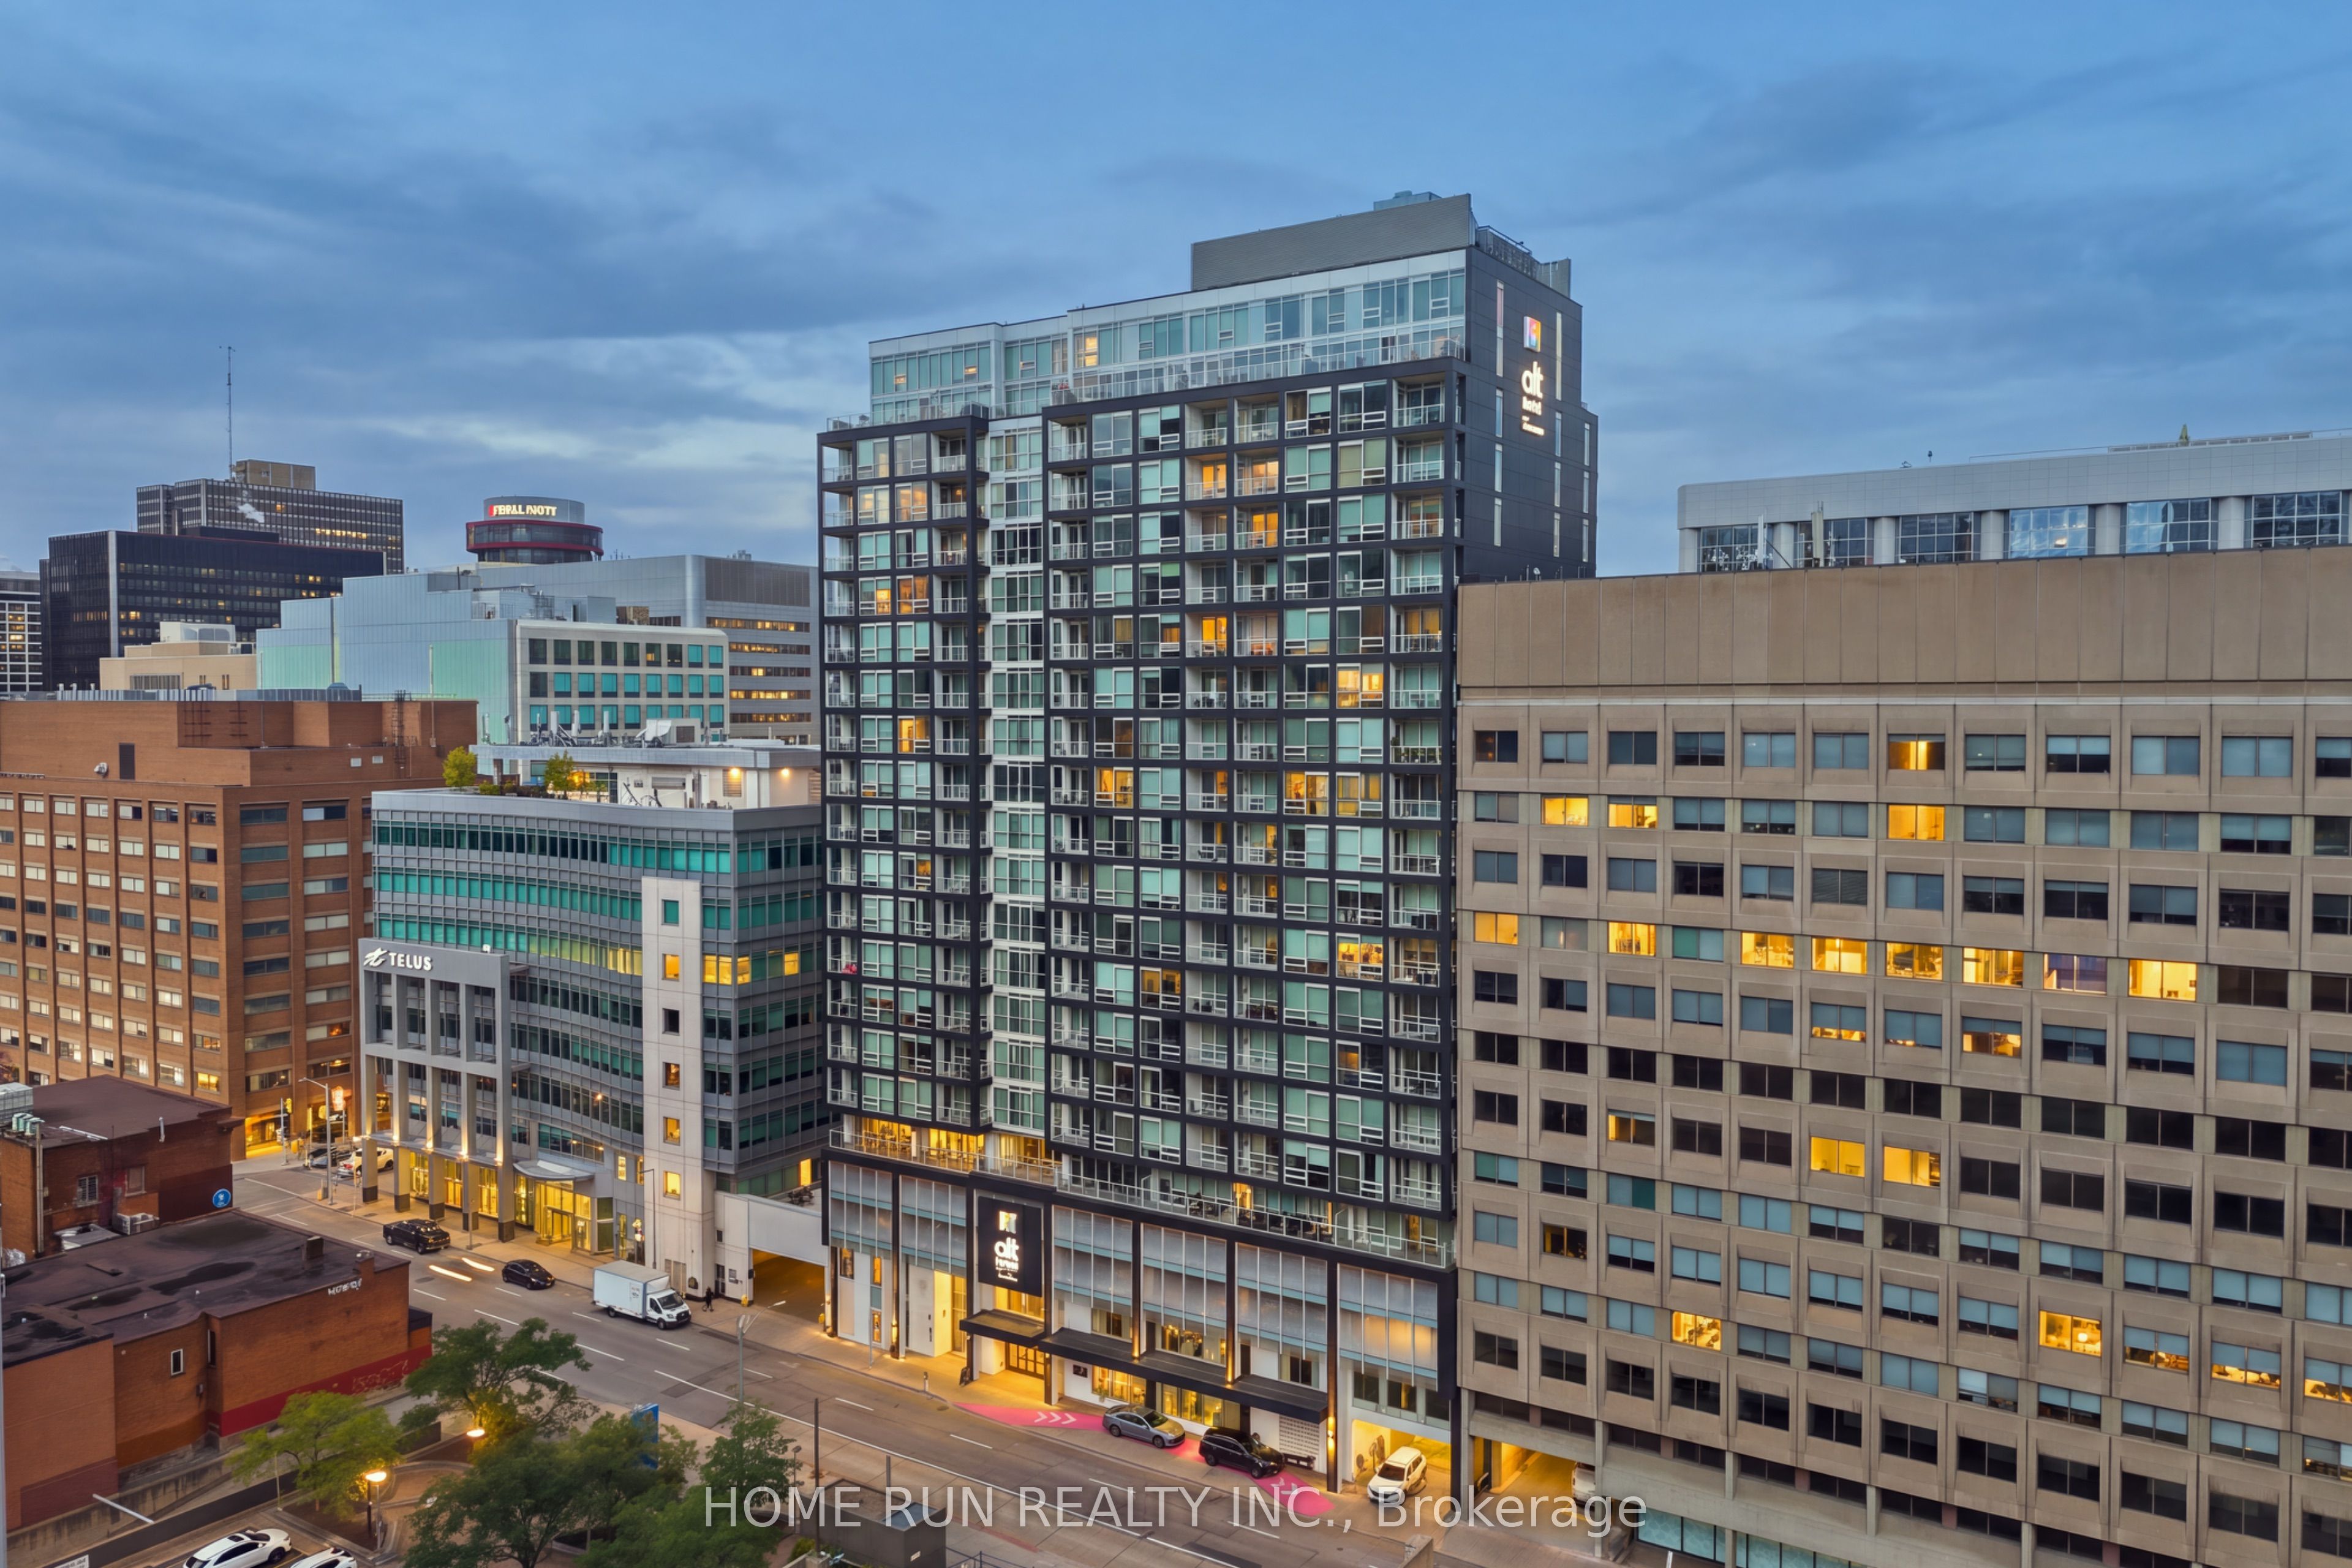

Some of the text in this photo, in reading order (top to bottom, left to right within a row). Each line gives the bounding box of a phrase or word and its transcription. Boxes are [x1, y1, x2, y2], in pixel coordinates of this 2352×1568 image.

[1521, 361, 1544, 399] alt
[388, 952, 432, 971] TELUS
[994, 1237, 1020, 1262] alt
